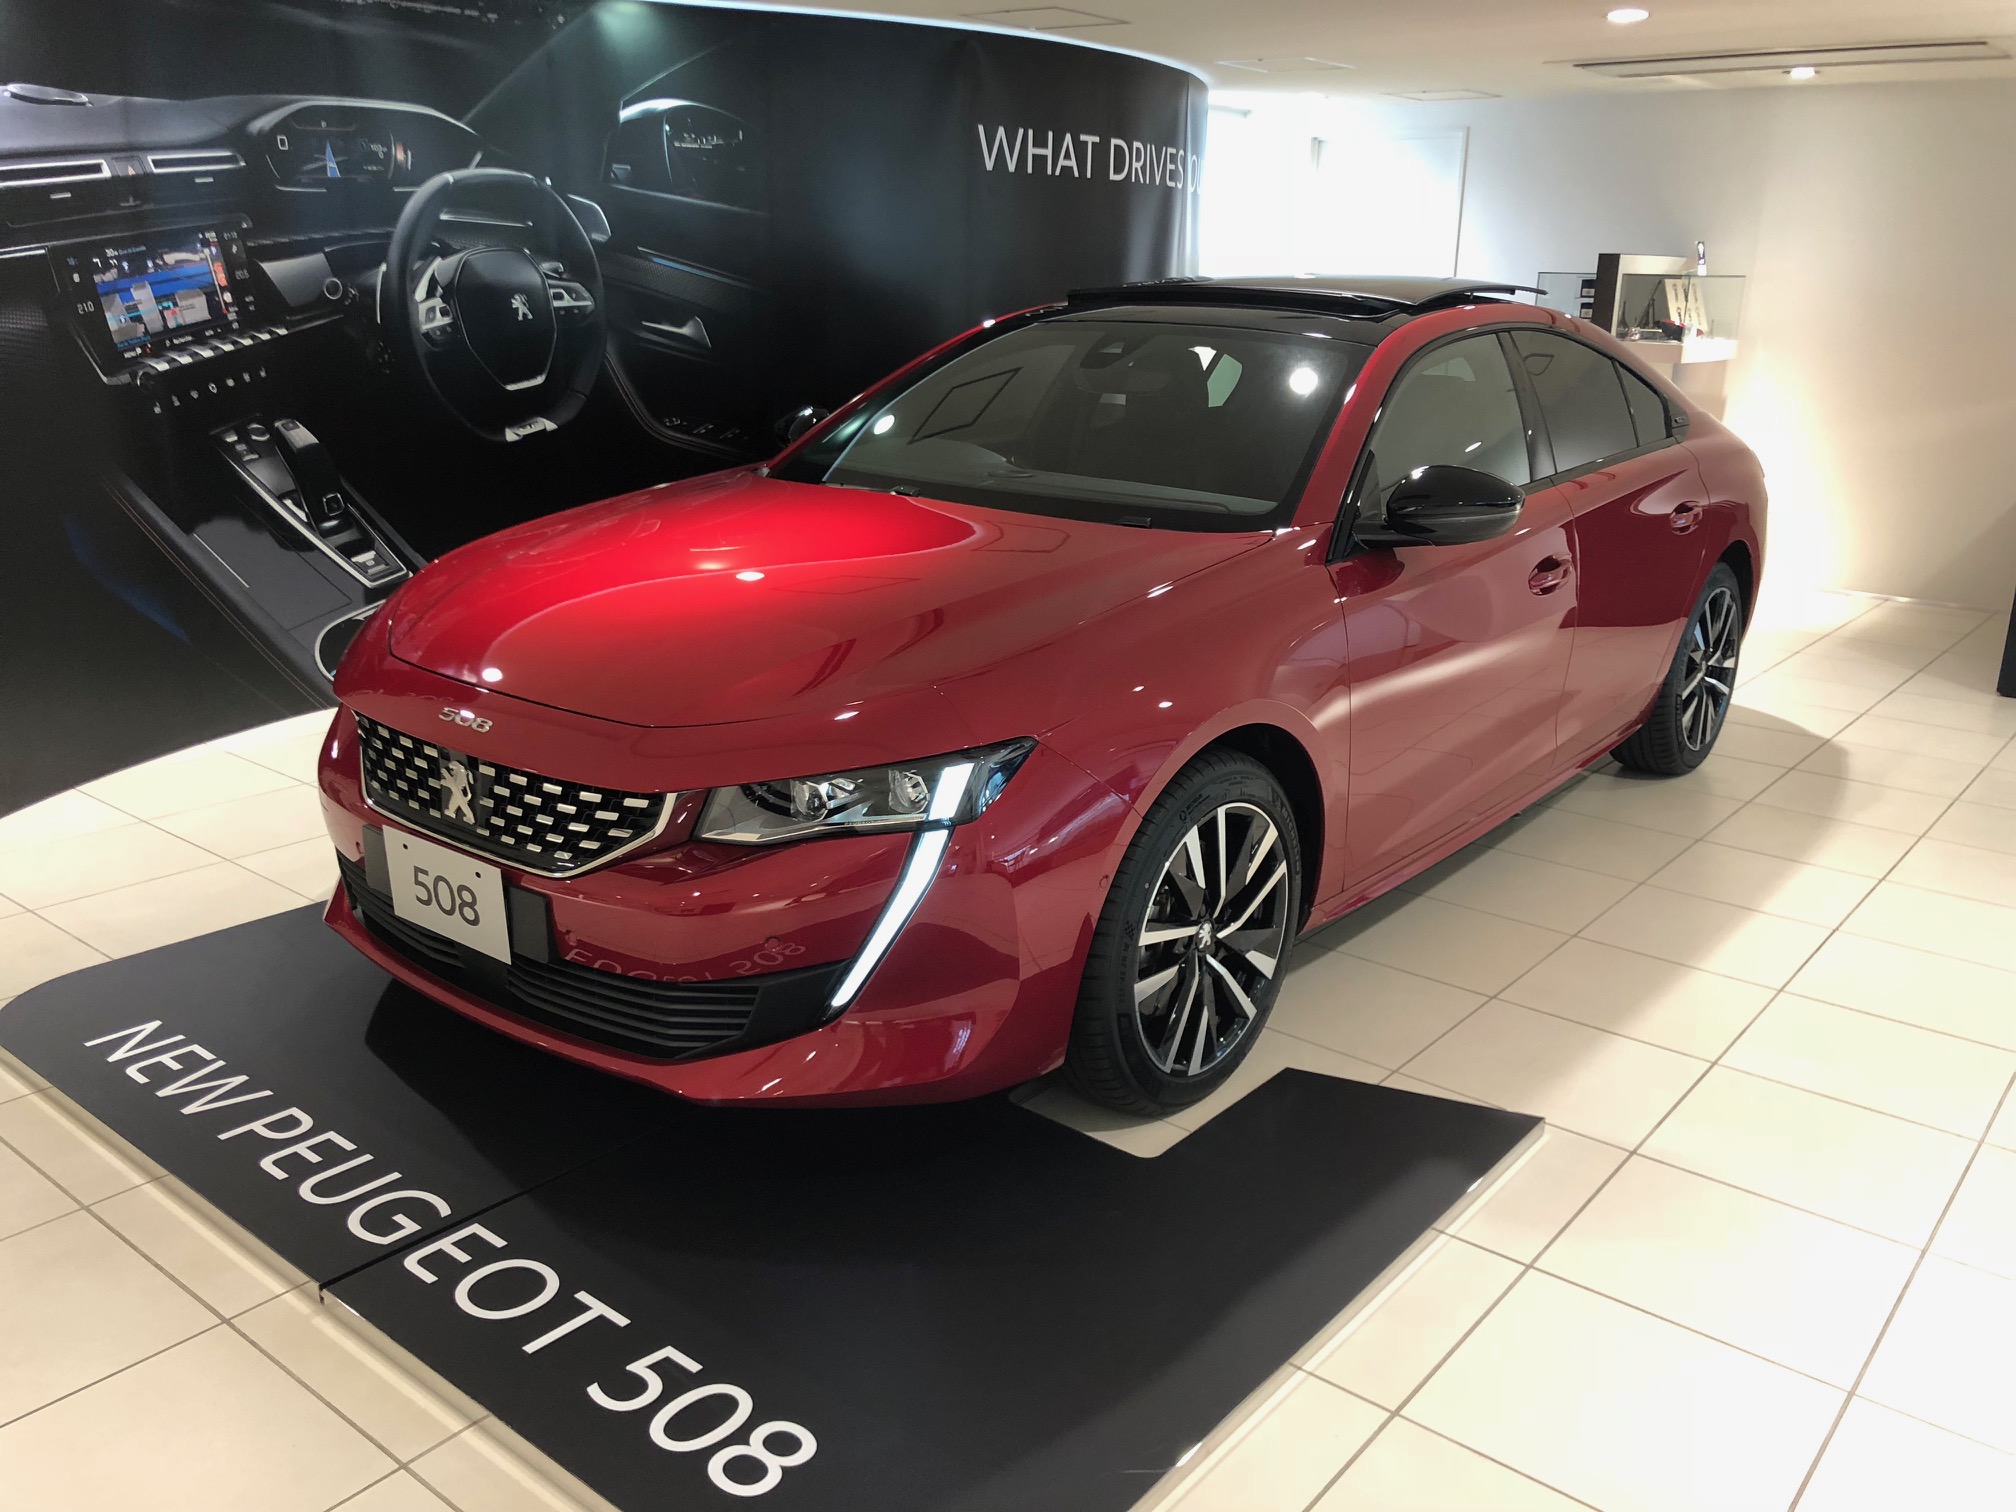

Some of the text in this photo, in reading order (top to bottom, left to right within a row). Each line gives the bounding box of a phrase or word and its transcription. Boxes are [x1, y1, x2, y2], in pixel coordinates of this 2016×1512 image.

[977, 124, 1100, 179] WHAT
[1109, 137, 1185, 190] DRIVES
[438, 706, 494, 733] 508
[413, 865, 481, 927] 508
[83, 1019, 818, 1497] NEW PEUGEOT 508
